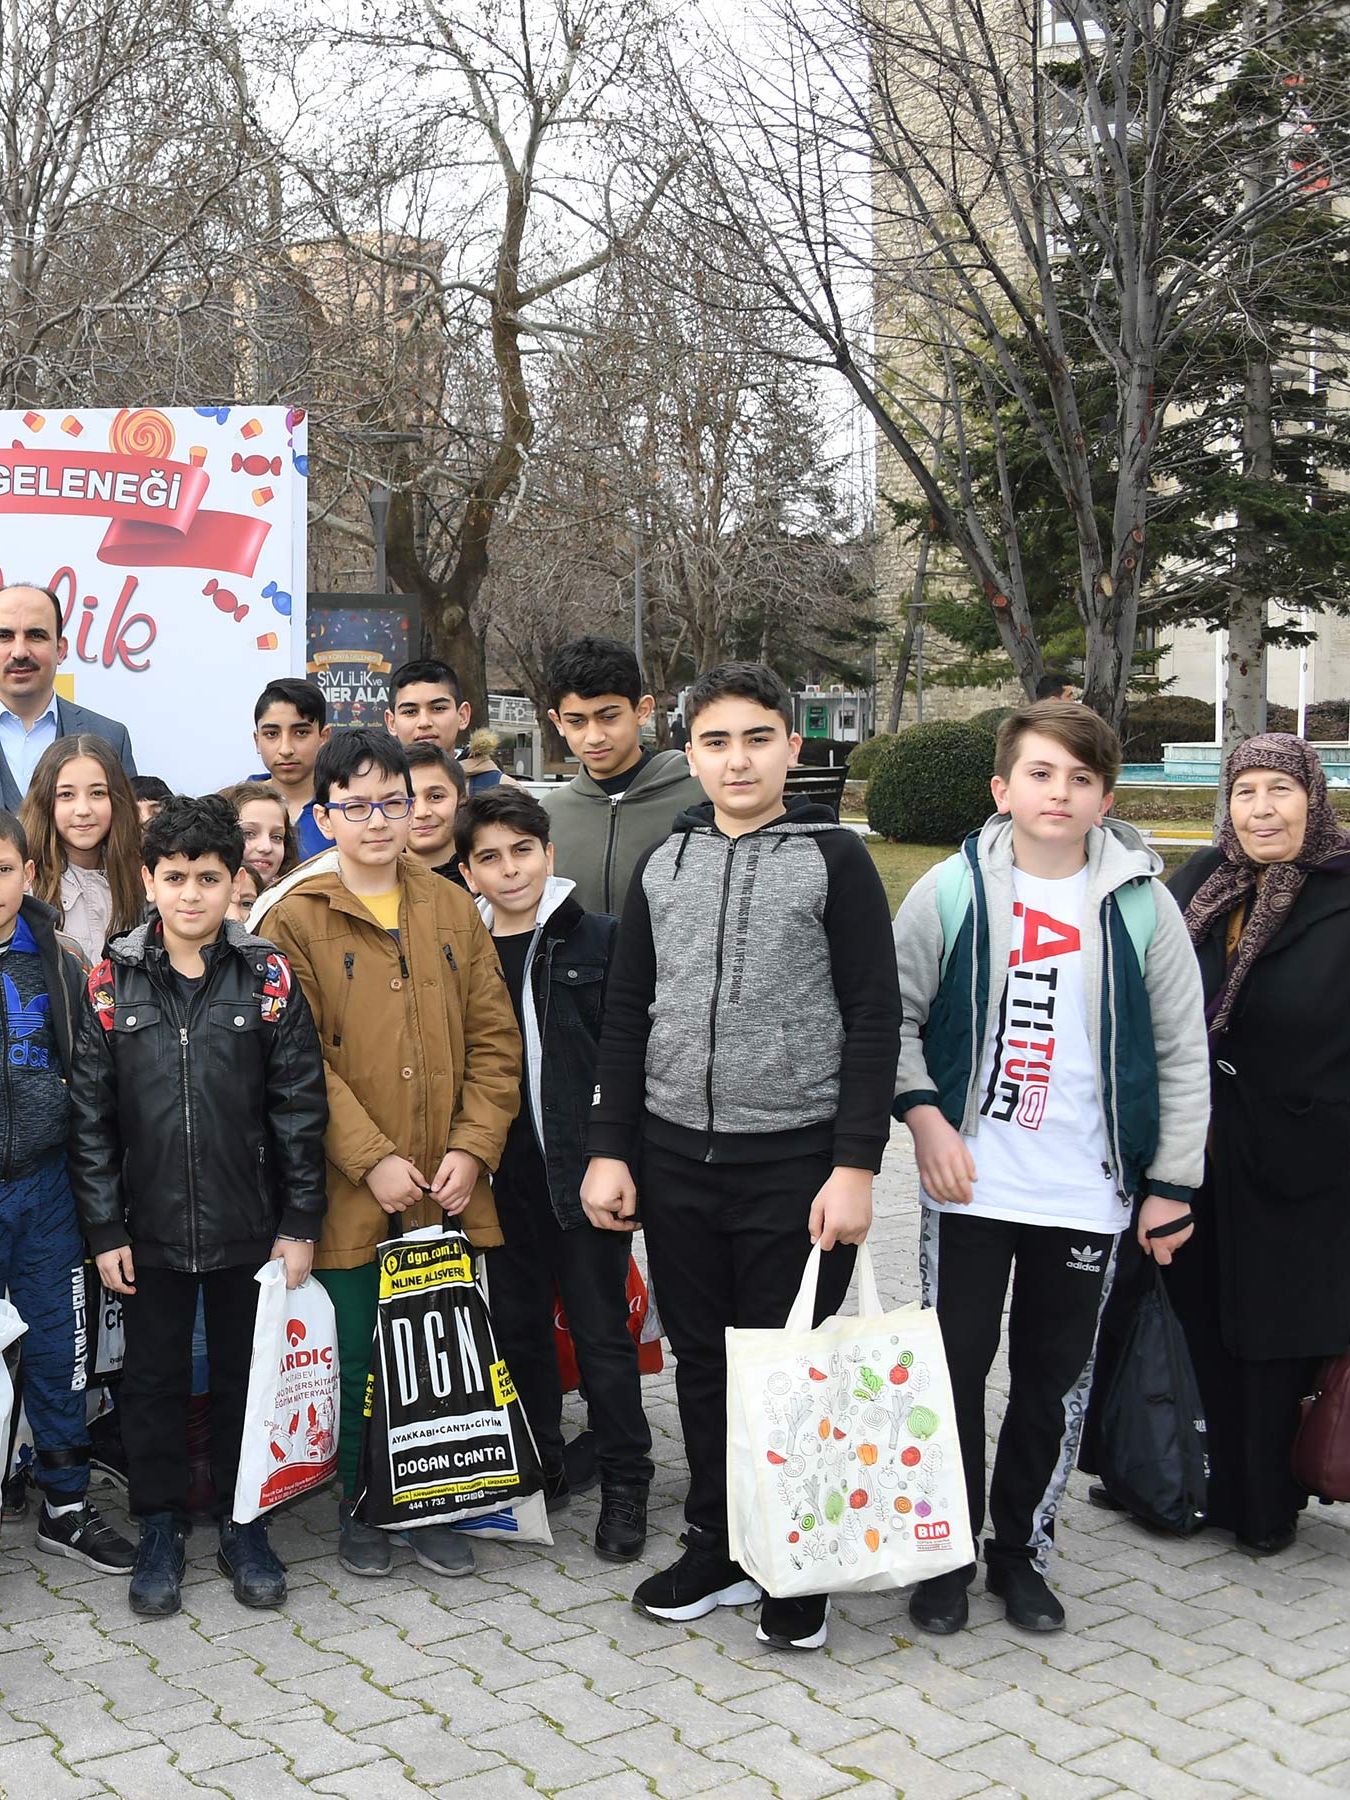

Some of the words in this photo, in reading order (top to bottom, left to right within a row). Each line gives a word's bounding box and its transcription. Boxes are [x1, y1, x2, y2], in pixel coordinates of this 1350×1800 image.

[319, 687, 351, 703] NER
[354, 687, 390, 703] ALA
[1066, 1261, 1101, 1273] adidas
[392, 1275, 422, 1289] NLINE
[391, 1305, 485, 1407] DGN
